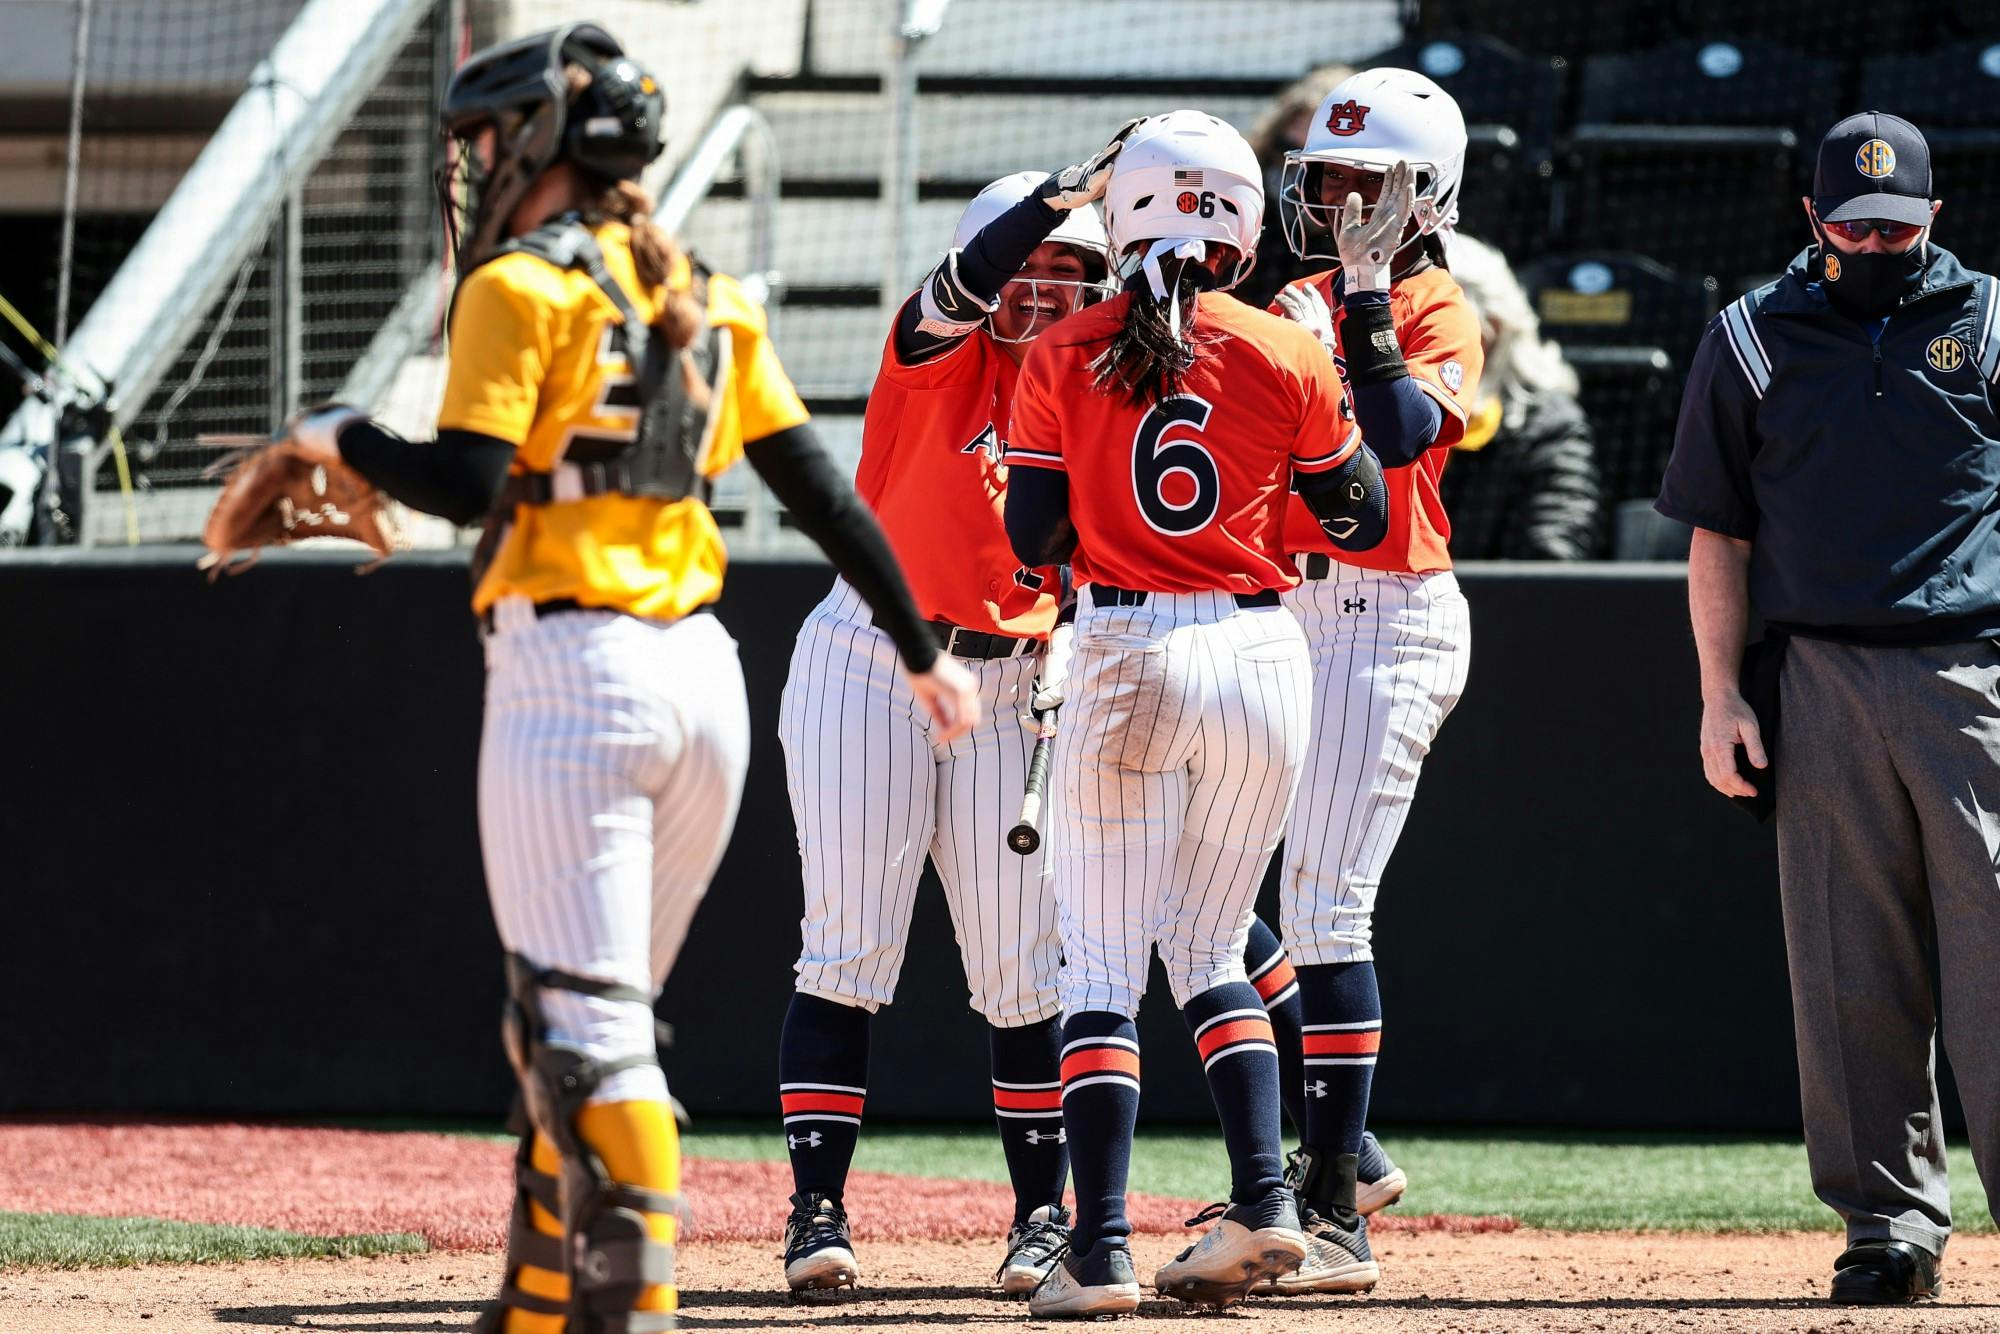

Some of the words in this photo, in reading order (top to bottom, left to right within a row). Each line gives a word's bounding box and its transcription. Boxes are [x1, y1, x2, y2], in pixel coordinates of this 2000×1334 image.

[1857, 140, 1895, 176] SEC
[1177, 192, 1198, 213] SEC
[1199, 191, 1216, 219] 6
[1928, 337, 1963, 370] SEC
[1131, 393, 1220, 537] 6
